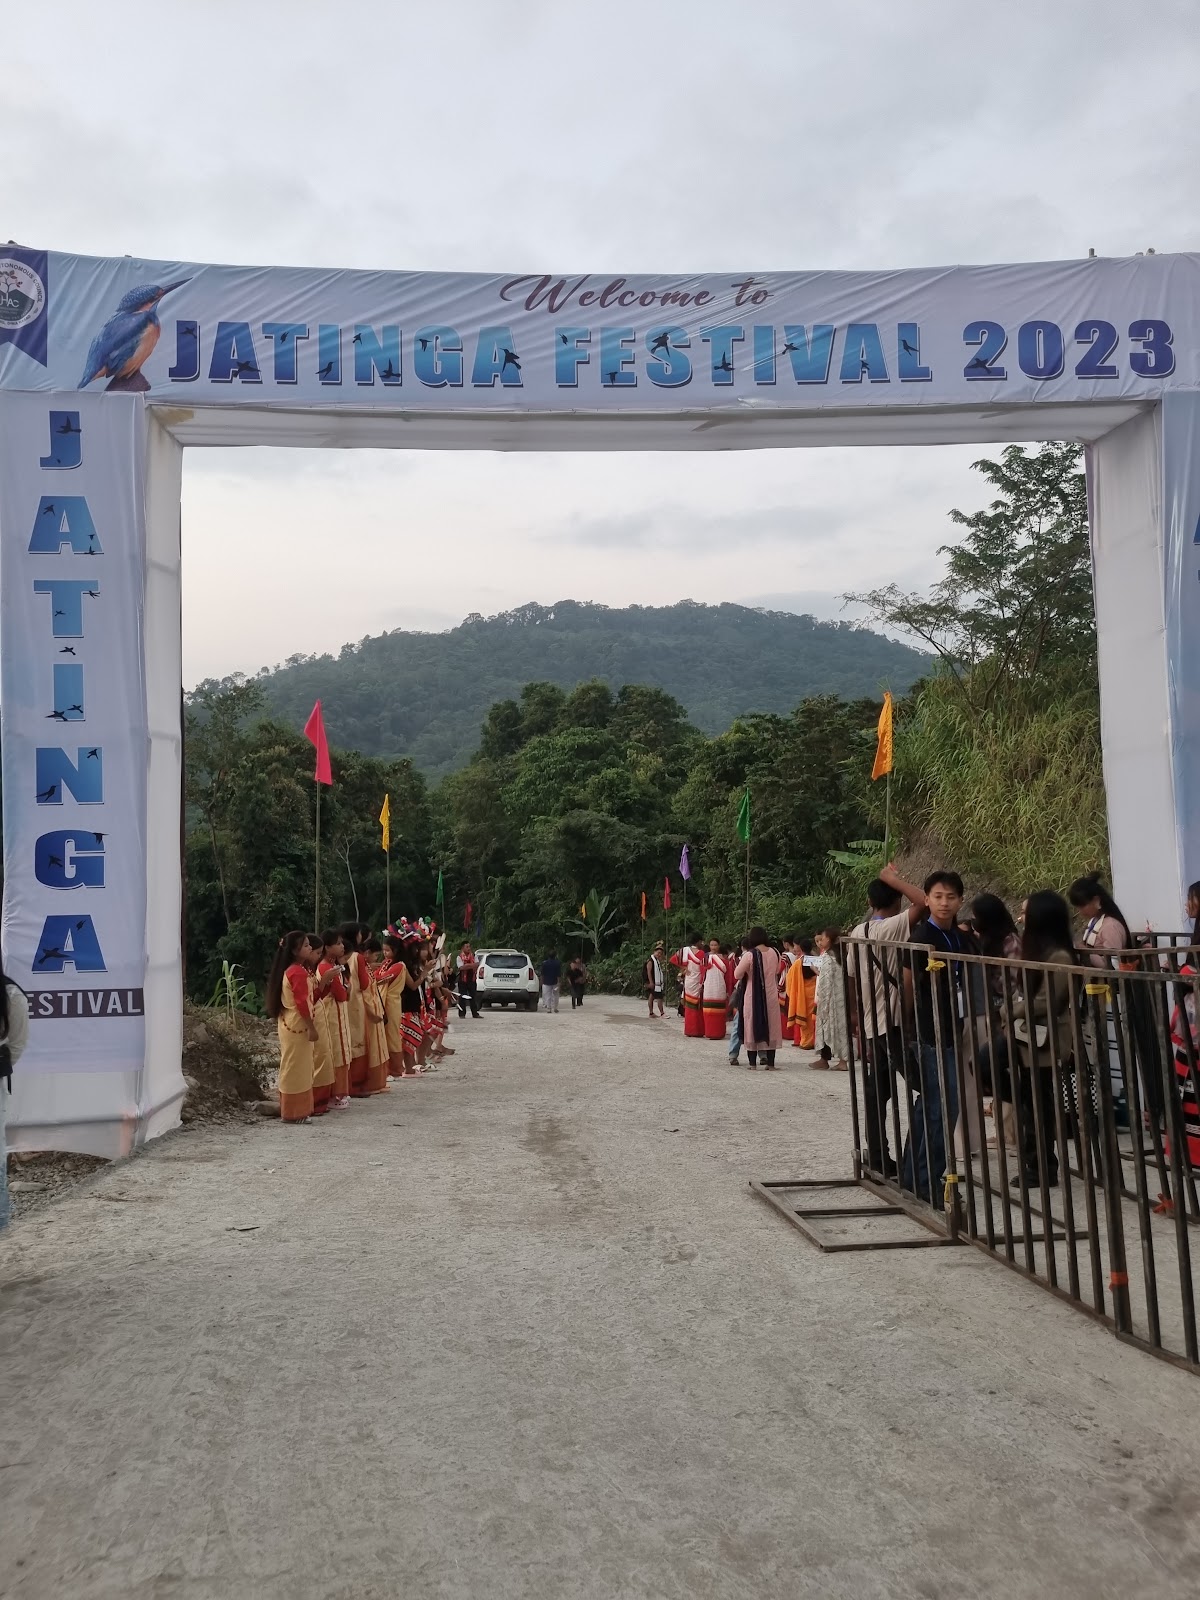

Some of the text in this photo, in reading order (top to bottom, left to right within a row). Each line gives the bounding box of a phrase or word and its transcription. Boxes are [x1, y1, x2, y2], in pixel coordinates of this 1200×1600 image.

[0, 262, 34, 280] TONOMOUS
[499, 274, 774, 313] Welcome to
[168, 319, 1176, 388] JATINGA FESTIVAL 2023
[26, 990, 142, 1016] ESTIVAL
